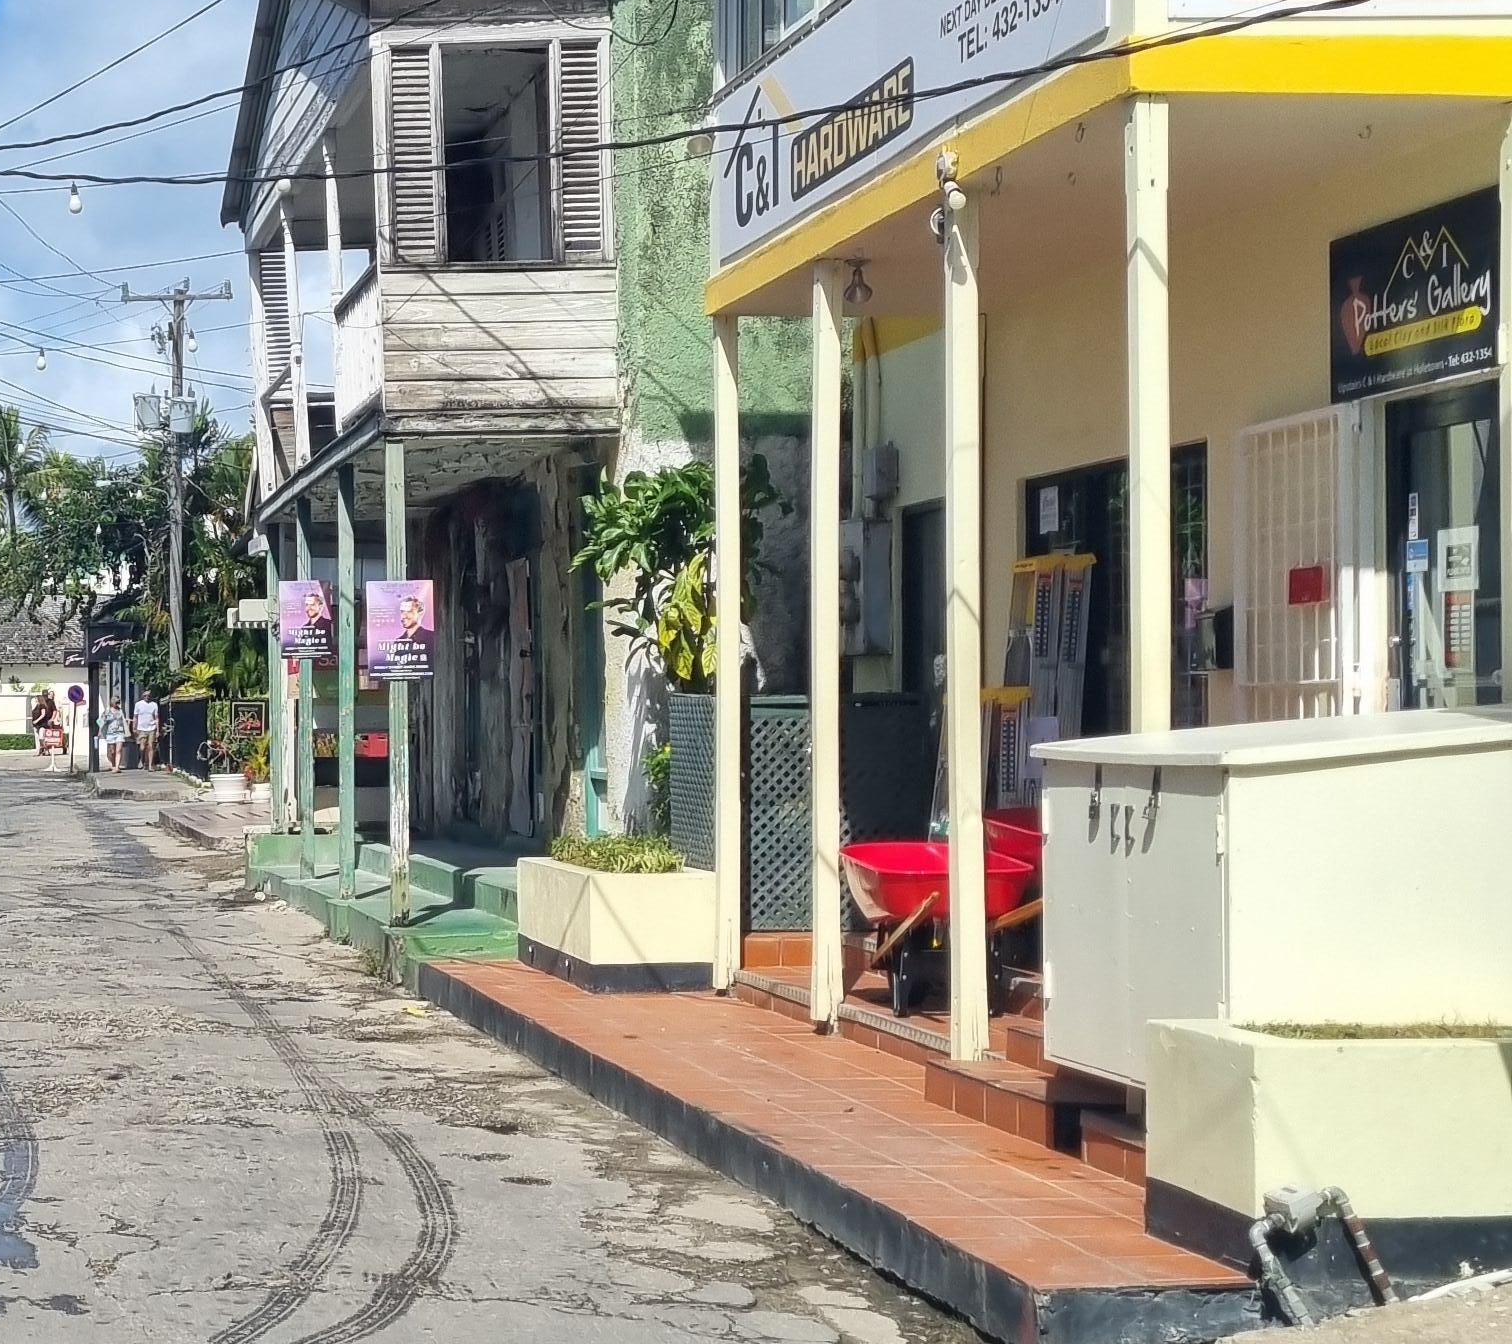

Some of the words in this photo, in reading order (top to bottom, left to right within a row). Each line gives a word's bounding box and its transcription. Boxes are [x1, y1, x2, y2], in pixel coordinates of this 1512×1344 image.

[939, 1, 963, 39] NEXT
[957, 24, 988, 64] TEL:
[793, 63, 911, 193] HARDWARE
[1427, 262, 1491, 317] Gallery
